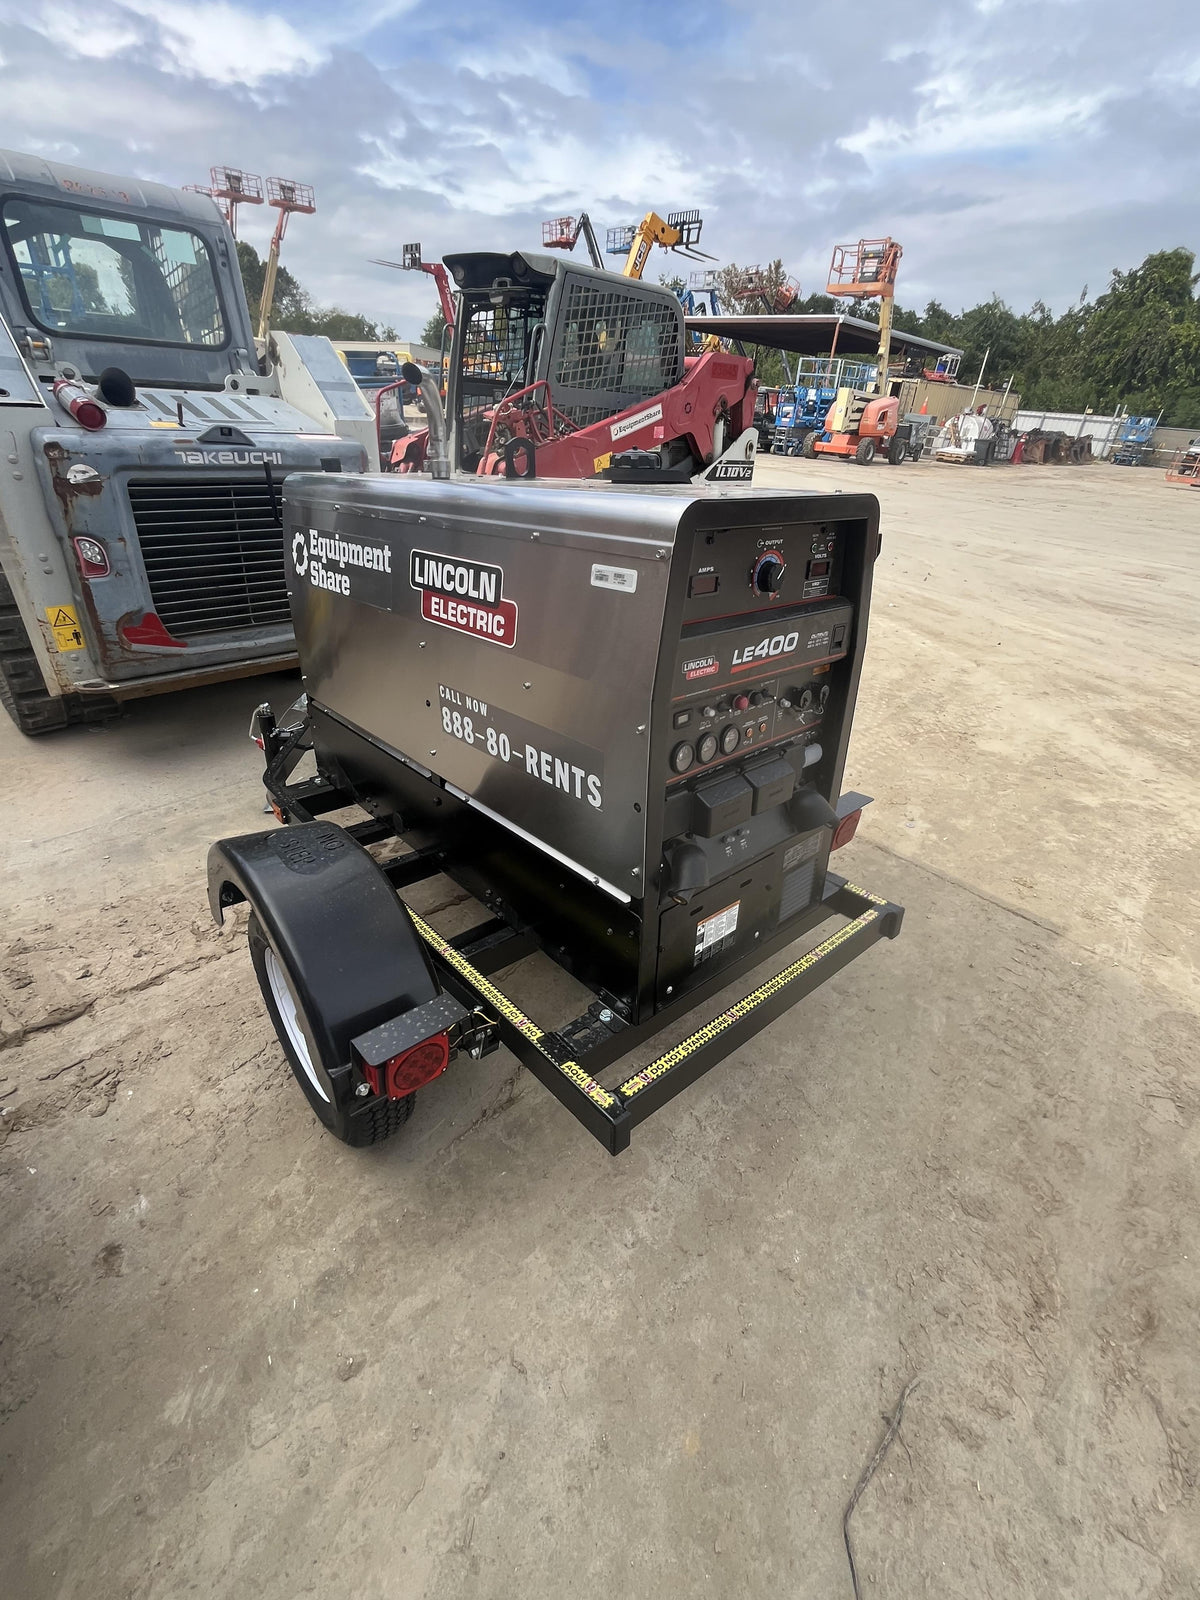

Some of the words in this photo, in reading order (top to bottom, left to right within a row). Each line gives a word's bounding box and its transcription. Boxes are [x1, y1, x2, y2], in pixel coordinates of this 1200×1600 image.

[634, 240, 647, 271] JCB
[617, 409, 661, 434] EquipmentShare
[174, 451, 282, 465] TAKEUCHI
[309, 528, 392, 574] Equipment
[310, 561, 351, 596] Share
[414, 557, 497, 603] LINCOLN
[430, 596, 505, 637] ELECTRIC
[731, 631, 799, 665] LE400
[683, 658, 713, 672] LINCOLN
[689, 666, 716, 678] ELECTRIC
[439, 684, 462, 706] CALL
[465, 695, 488, 717] NOW
[441, 706, 602, 809] 888-80-RENTS
[280, 839, 317, 864] STEP
[315, 832, 345, 851] NO
[484, 986, 511, 1010] DEBOUT
[747, 994, 761, 1006] PAS
[780, 961, 805, 982] DEBOUT
[525, 1026, 538, 1037] NO
[650, 1063, 665, 1075] DO
[664, 1050, 682, 1065] NOT
[682, 1031, 709, 1052] STAND
[708, 1017, 729, 1036] HERE
[565, 1065, 585, 1083] AQUI
